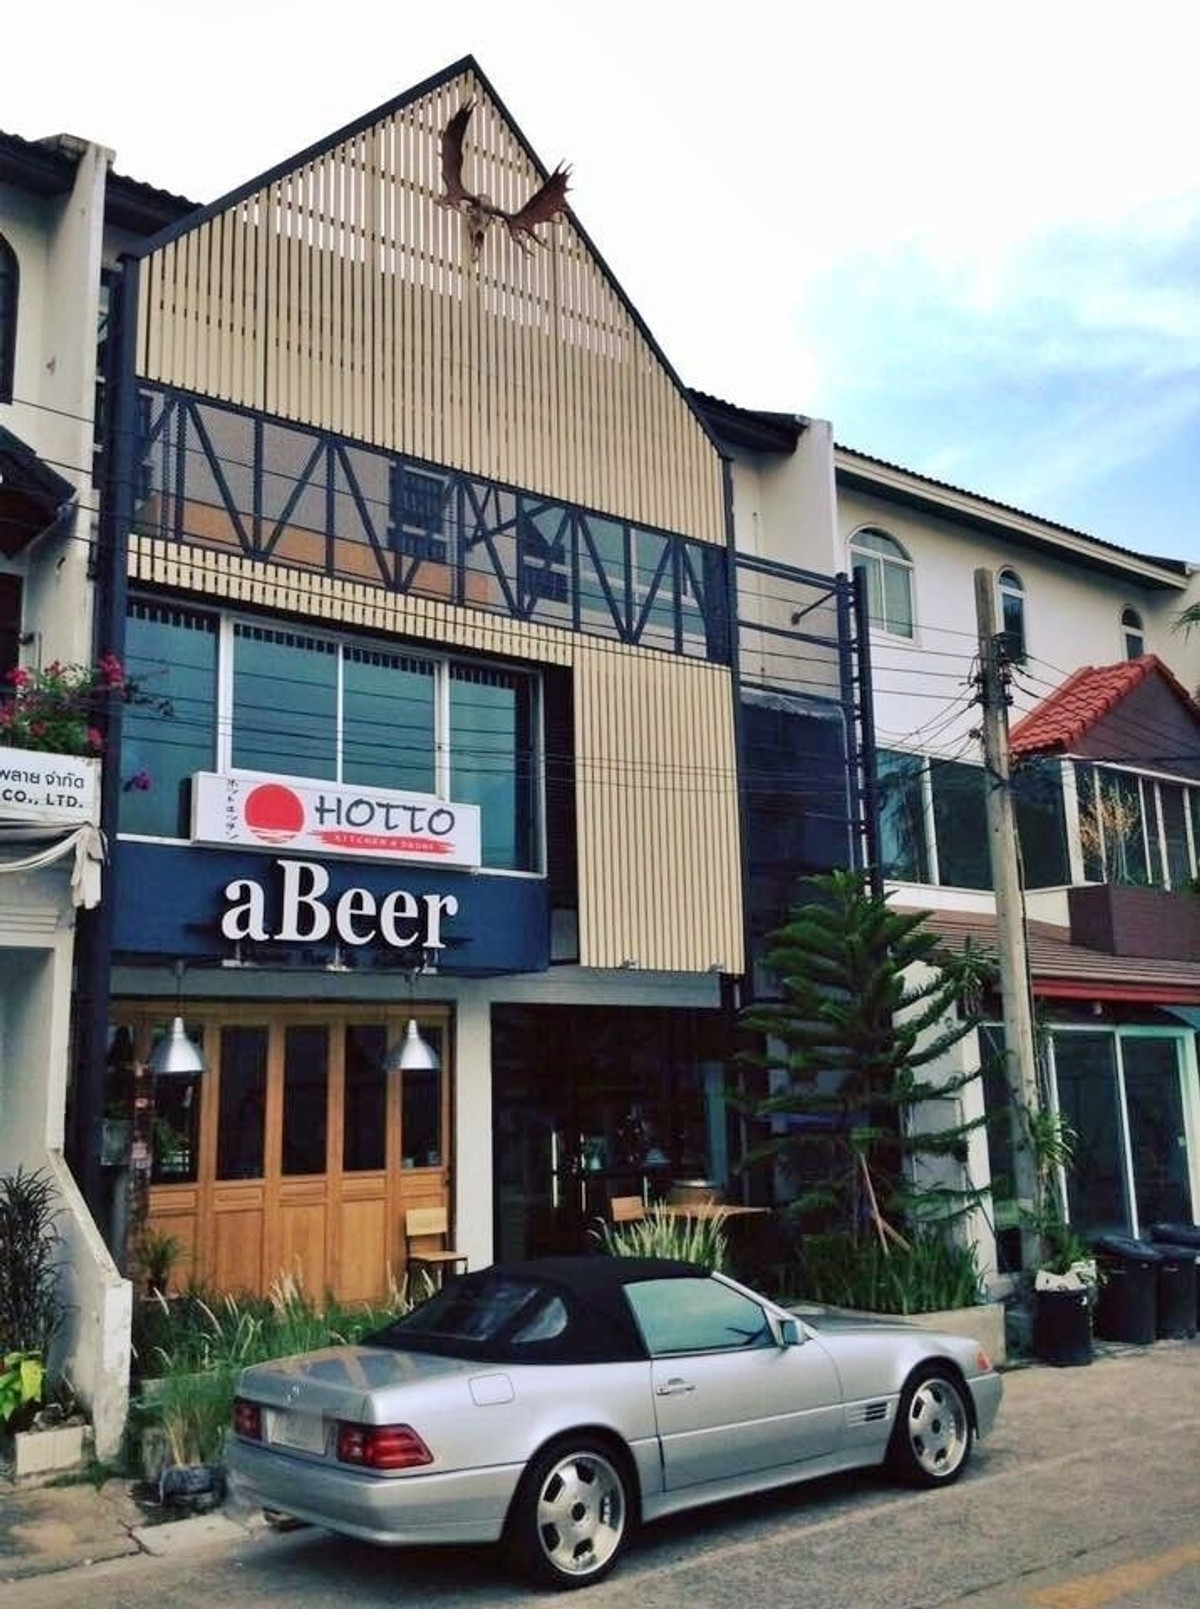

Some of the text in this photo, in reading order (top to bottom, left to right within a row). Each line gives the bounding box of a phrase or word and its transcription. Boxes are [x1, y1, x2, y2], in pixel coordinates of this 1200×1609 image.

[45, 770, 84, 789] จำกัด
[2, 788, 84, 808] CO., LTD.
[315, 795, 456, 836] HOTTO
[221, 859, 459, 948] aBeer
